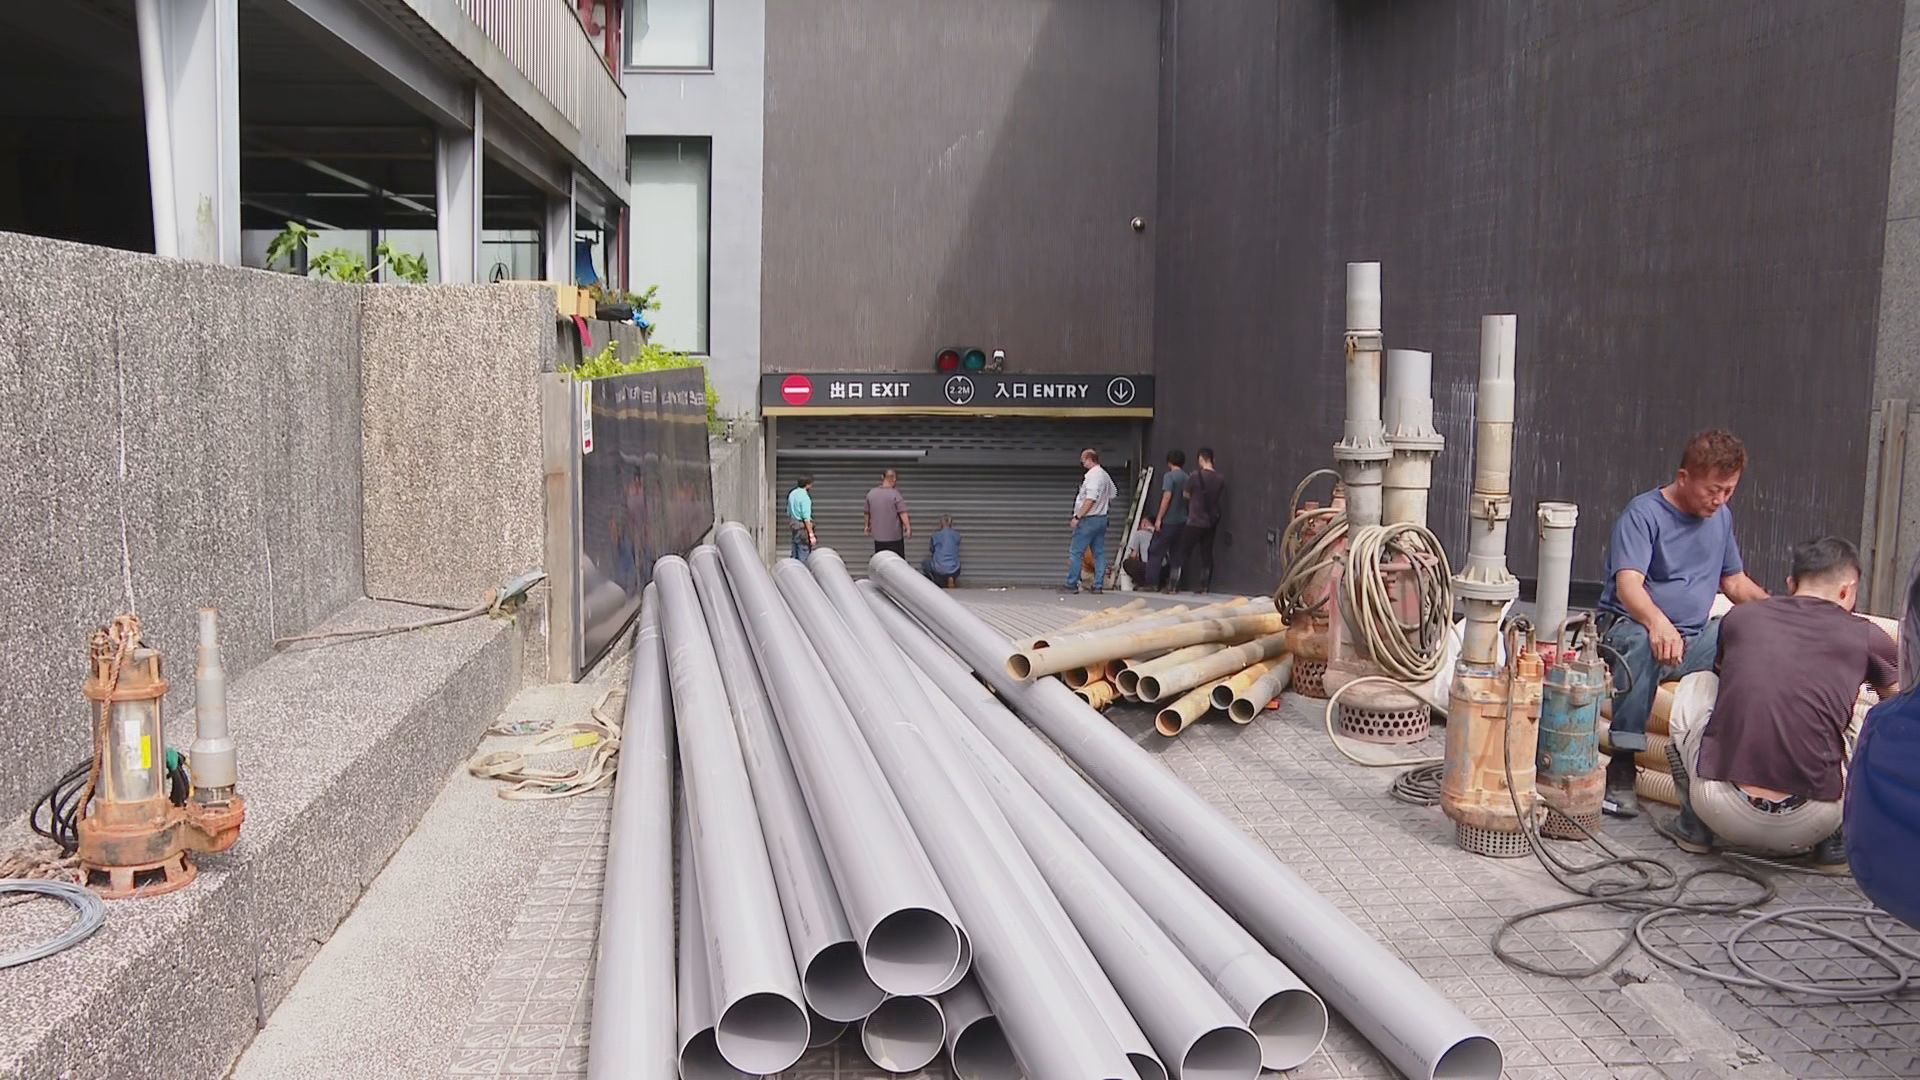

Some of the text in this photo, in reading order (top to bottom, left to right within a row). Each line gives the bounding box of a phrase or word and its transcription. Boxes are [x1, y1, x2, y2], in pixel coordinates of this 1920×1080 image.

[830, 382, 910, 399] 出口 EXIT
[949, 386, 970, 394] 2.2M
[995, 382, 1089, 398] 入口 ENTRY
